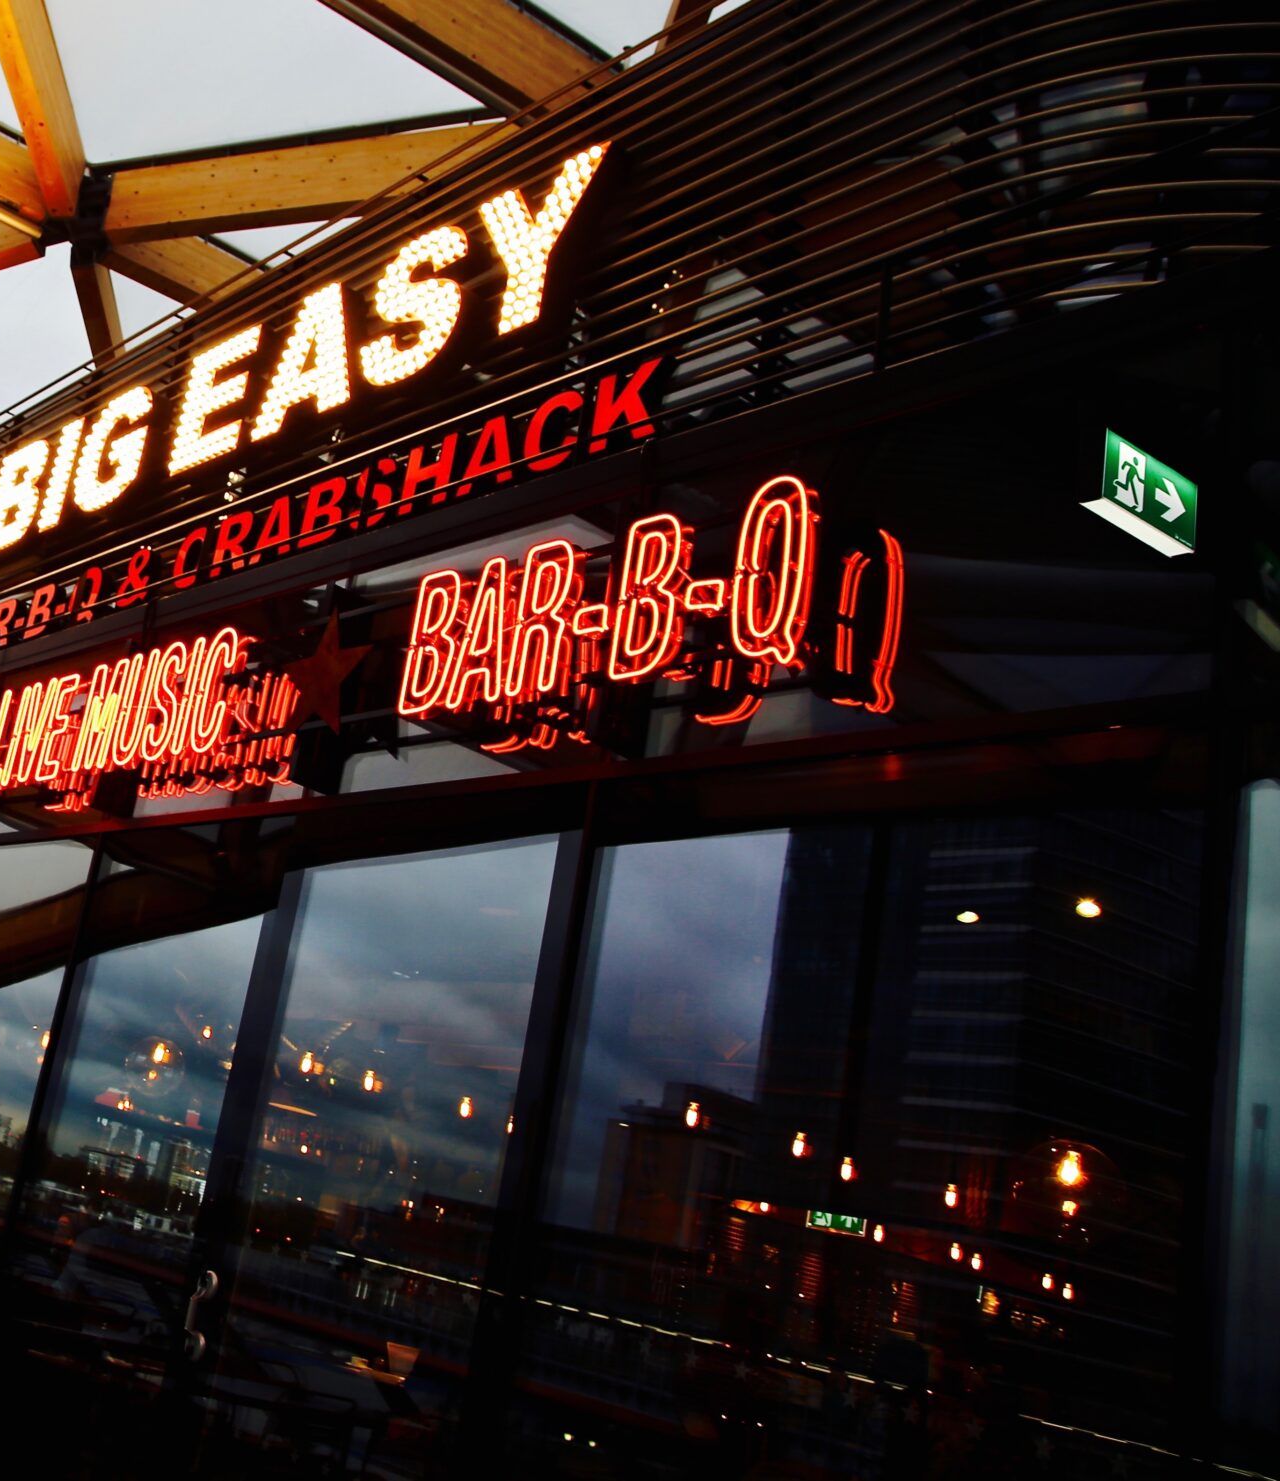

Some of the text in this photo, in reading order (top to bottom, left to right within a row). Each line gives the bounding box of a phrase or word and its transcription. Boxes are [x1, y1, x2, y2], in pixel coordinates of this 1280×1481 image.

[169, 141, 613, 476] EASY
[116, 549, 152, 607] &
[397, 475, 808, 716] BAR-B-Q
[70, 626, 239, 773] MUSIC
